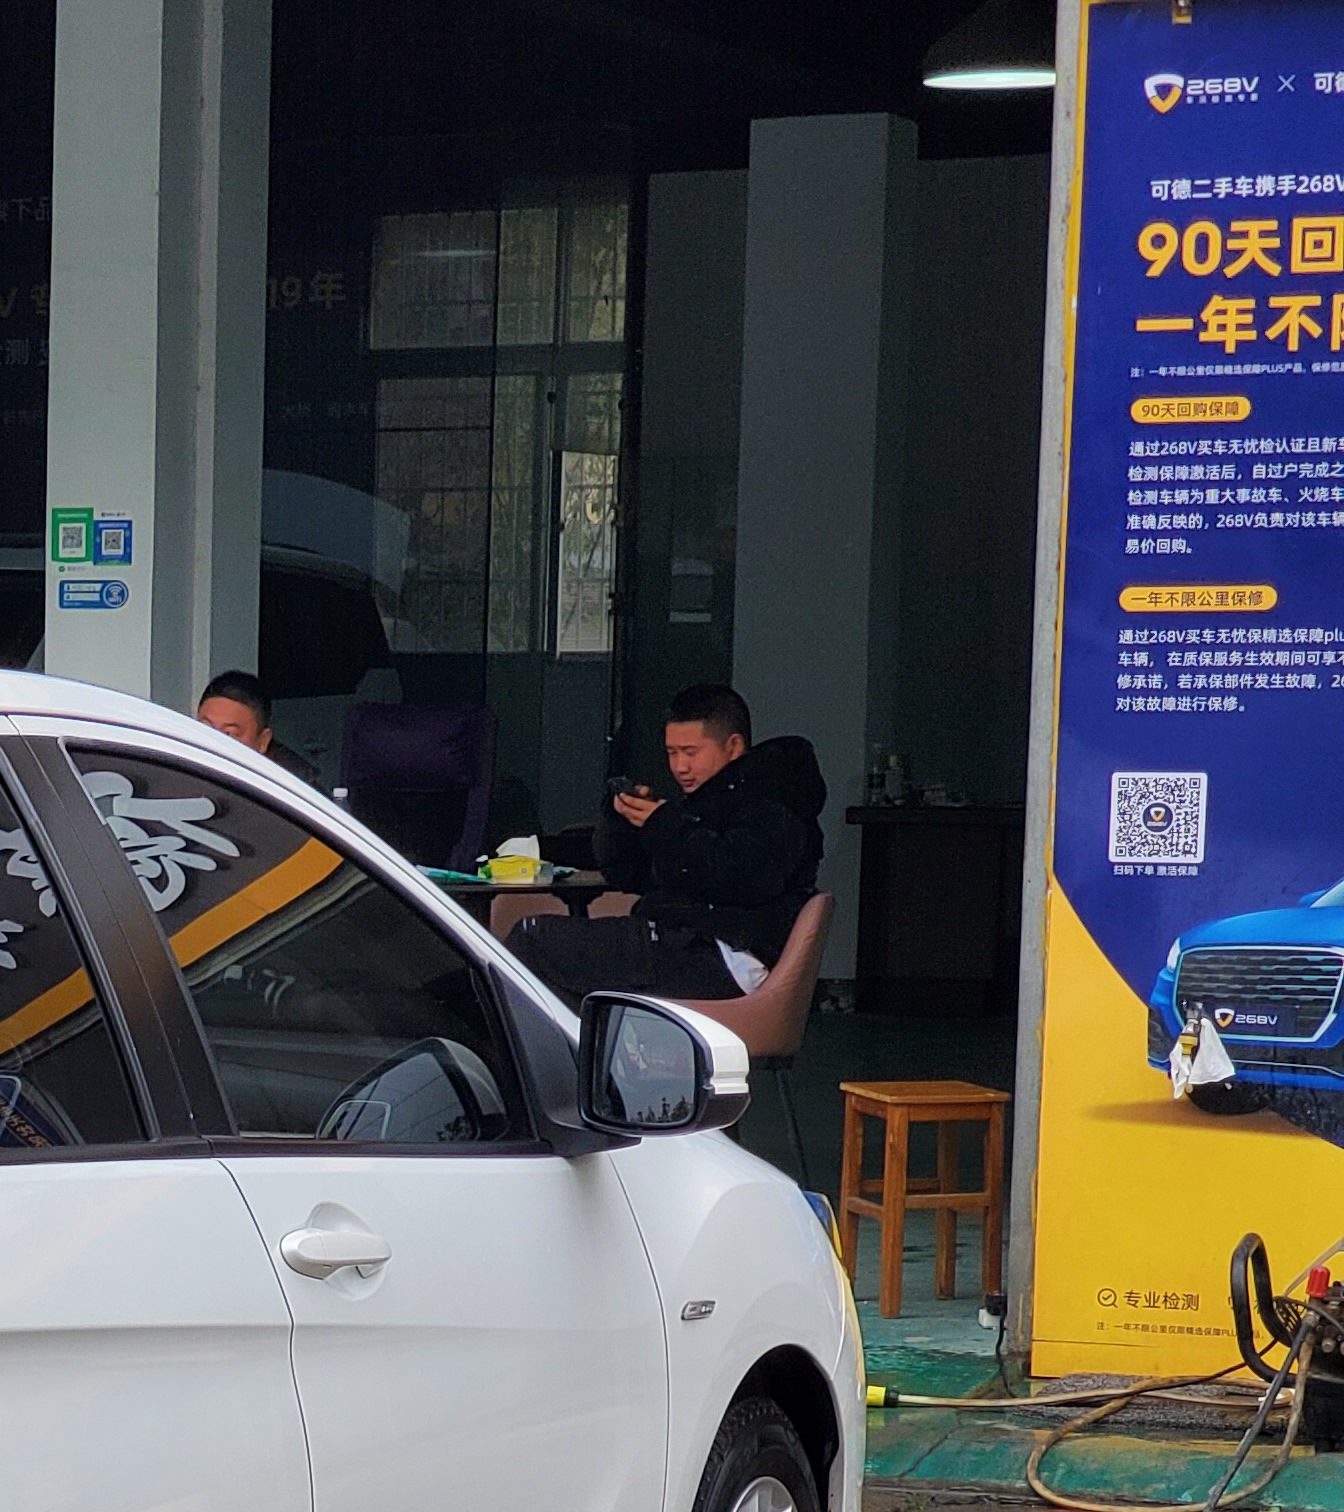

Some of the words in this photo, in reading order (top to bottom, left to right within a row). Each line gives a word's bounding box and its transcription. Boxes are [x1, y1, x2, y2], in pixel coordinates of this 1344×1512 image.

[1186, 76, 1260, 95] 268V
[1138, 216, 1344, 278] 90天回
[1136, 294, 1344, 353] 一年不
[1141, 401, 1240, 418] 90天回购保障
[1130, 589, 1264, 607] 一年不限公里保修
[1113, 865, 1155, 876] 扫码下单
[1234, 1014, 1278, 1025] 268V
[1123, 1290, 1200, 1312] 专业检测
